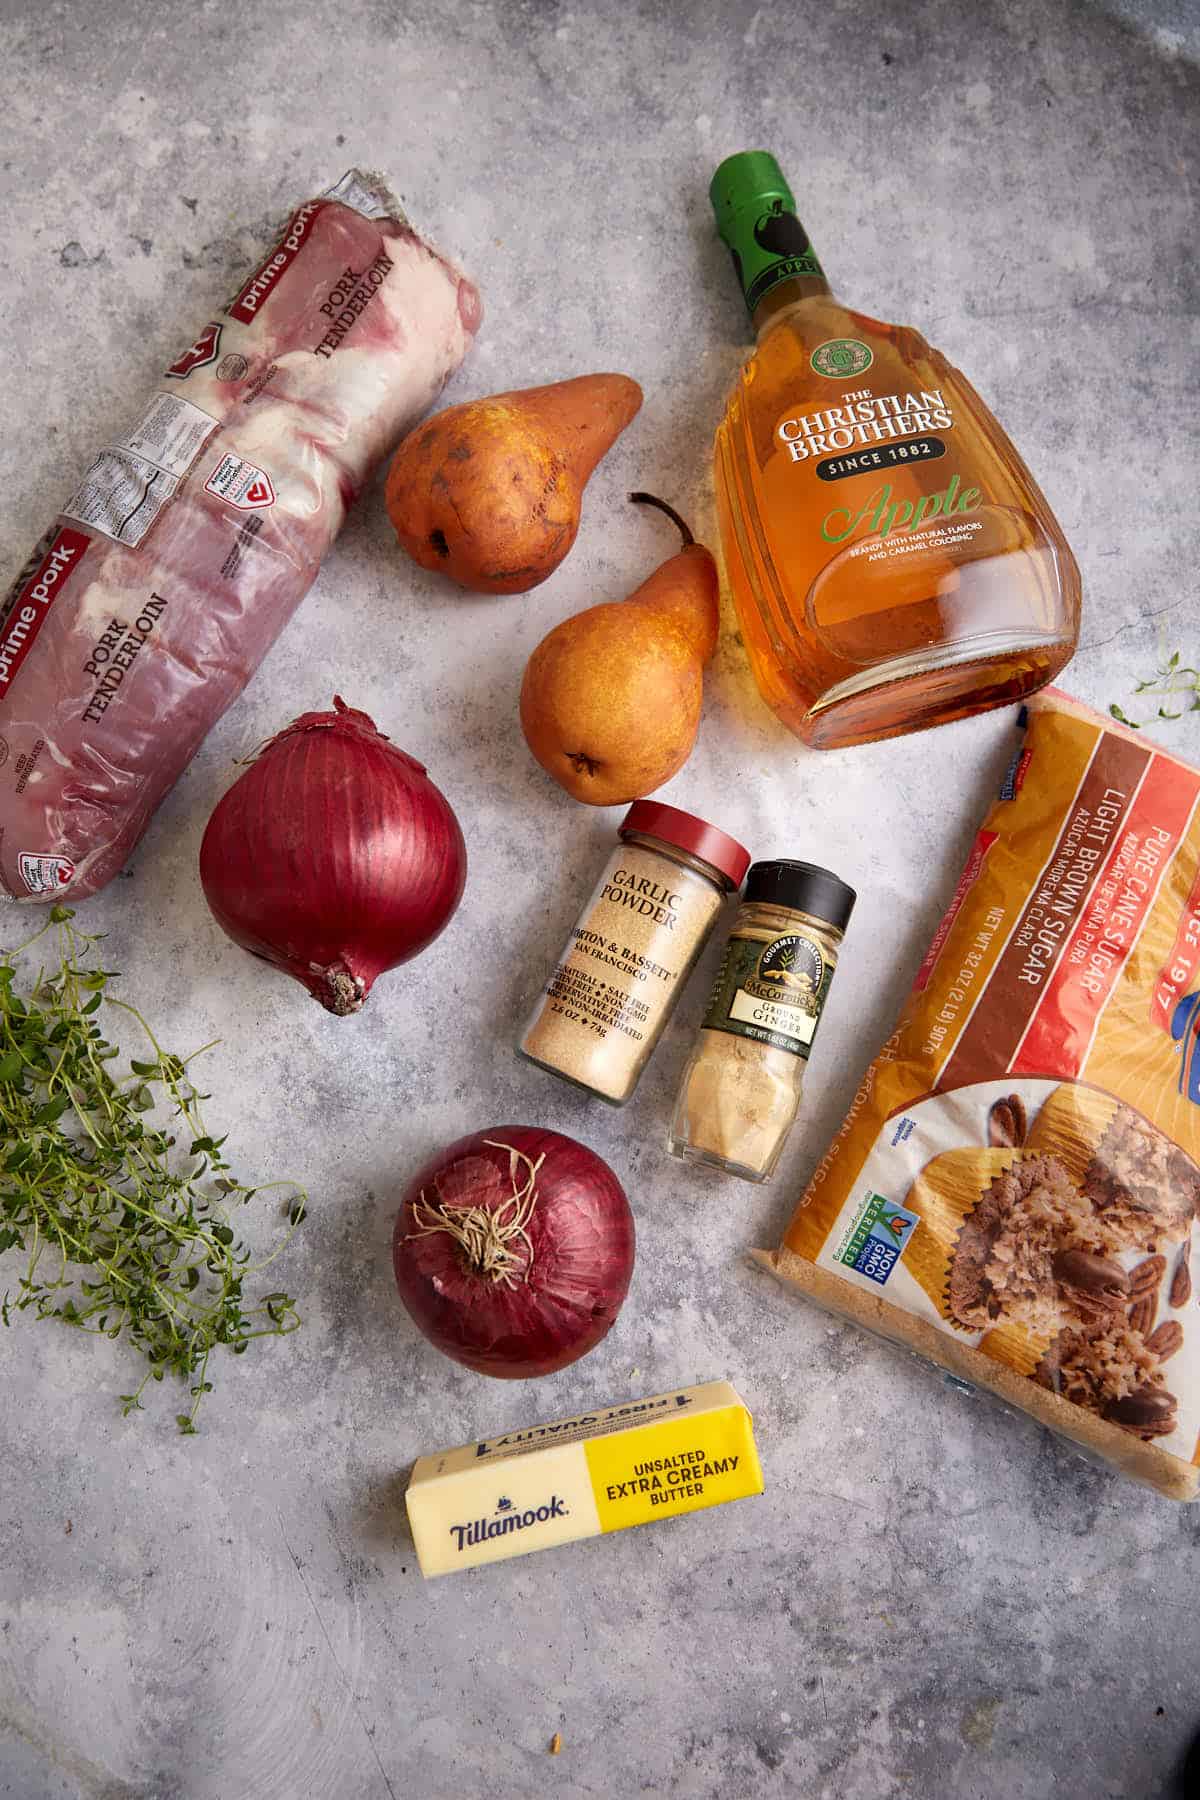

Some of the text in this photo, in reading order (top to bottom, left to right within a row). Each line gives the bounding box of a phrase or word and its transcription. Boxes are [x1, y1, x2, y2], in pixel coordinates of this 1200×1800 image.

[240, 202, 319, 313] prime pork
[314, 253, 395, 360] TENDERLOIN
[319, 266, 362, 318] PORK
[778, 389, 946, 442] CHRISTIAN
[842, 389, 872, 403] THE
[787, 409, 953, 462] BROTHERS
[828, 443, 931, 475] SINCE 1882
[820, 474, 983, 543] Apple
[849, 522, 983, 557] BRANDY WITH NATURAL FLAVORS
[868, 551, 887, 562] AND
[889, 542, 928, 556] CARAMEL
[929, 533, 974, 547] COLORING
[30, 543, 76, 604] pork
[82, 592, 168, 724] TENDERLOIN
[83, 618, 128, 678] PORK
[613, 870, 683, 911] GARLIC
[1018, 789, 1126, 985] LIGHT BROWN SUGAR
[1035, 858, 1070, 904] MORENA
[1103, 880, 1119, 901] DE
[600, 884, 677, 931] POWDER
[984, 906, 1005, 932] NET
[1014, 904, 1044, 947] CLARA
[1080, 826, 1171, 994] PURE CANE SUGAR
[762, 936, 823, 982] GOURMET COLLECTION
[964, 950, 982, 970] 32
[976, 930, 993, 951] WT
[1069, 928, 1096, 964] PURA
[574, 942, 648, 982] SAN FRANCISCO
[607, 942, 618, 954] &
[620, 948, 671, 981] BASSETT
[956, 969, 974, 987] OZ
[563, 965, 598, 986] NATURAL
[607, 985, 629, 1002] SALT
[750, 982, 811, 1006] McCormick
[1158, 956, 1192, 1009] 1917
[564, 1009, 580, 1022] OZ
[590, 1022, 607, 1038] 74g
[568, 998, 643, 1041] NON-IRRADIATED
[941, 1002, 959, 1025] LB)
[922, 1024, 948, 1055] 907g
[802, 1143, 840, 1209] SUGAR
[844, 1200, 882, 1262] VERIFIED
[855, 1238, 877, 1269] Project
[864, 1244, 885, 1274] GMO
[874, 1248, 897, 1280] NON
[605, 1399, 667, 1419] FIRST
[496, 1416, 598, 1447] QUALITY
[606, 1456, 740, 1502] EXTRA CREAMY
[634, 1450, 706, 1477] UNSALTED
[650, 1482, 704, 1506] BUTTER
